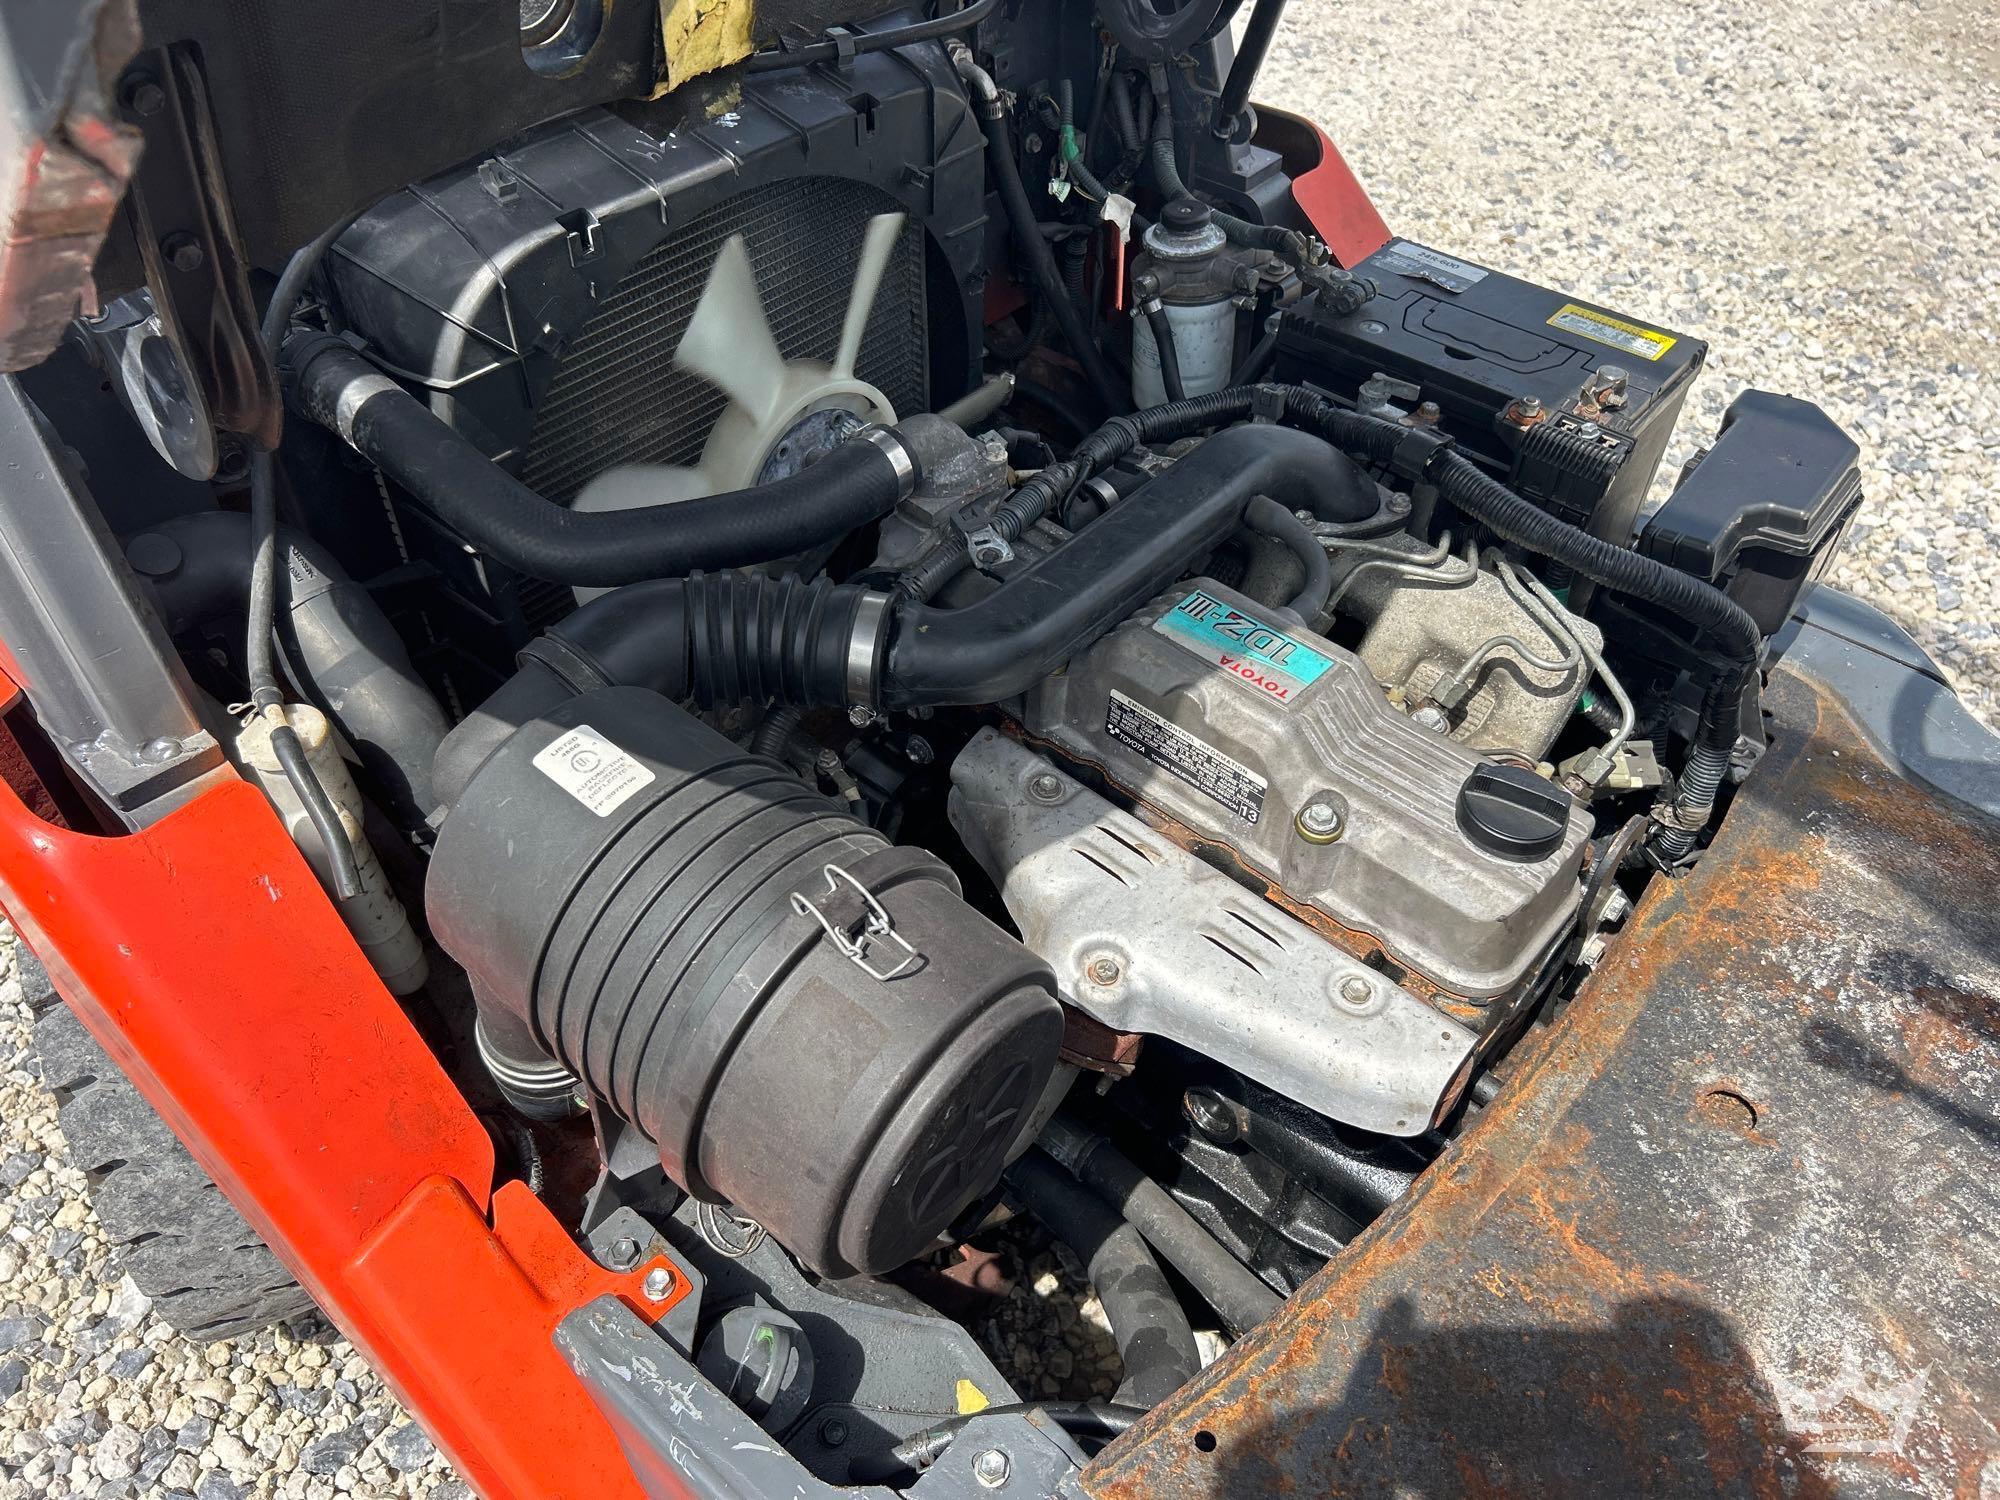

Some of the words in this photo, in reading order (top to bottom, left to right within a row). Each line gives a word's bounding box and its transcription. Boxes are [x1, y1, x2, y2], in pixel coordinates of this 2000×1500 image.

[1219, 655, 1289, 699] TOYOTA
[1118, 732, 1145, 753] TOYOTA
[1127, 699, 1159, 722] EMISSION
[1163, 721, 1195, 743] CONTROL
[1199, 742, 1248, 775] INFORMATION
[576, 755, 625, 794] AUTOMOTIVE
[1150, 753, 1170, 768] TOYOTA
[1170, 765, 1200, 786] INDUSTRIES
[1200, 783, 1238, 809] CORPORATION
[1240, 804, 1257, 823] 13
